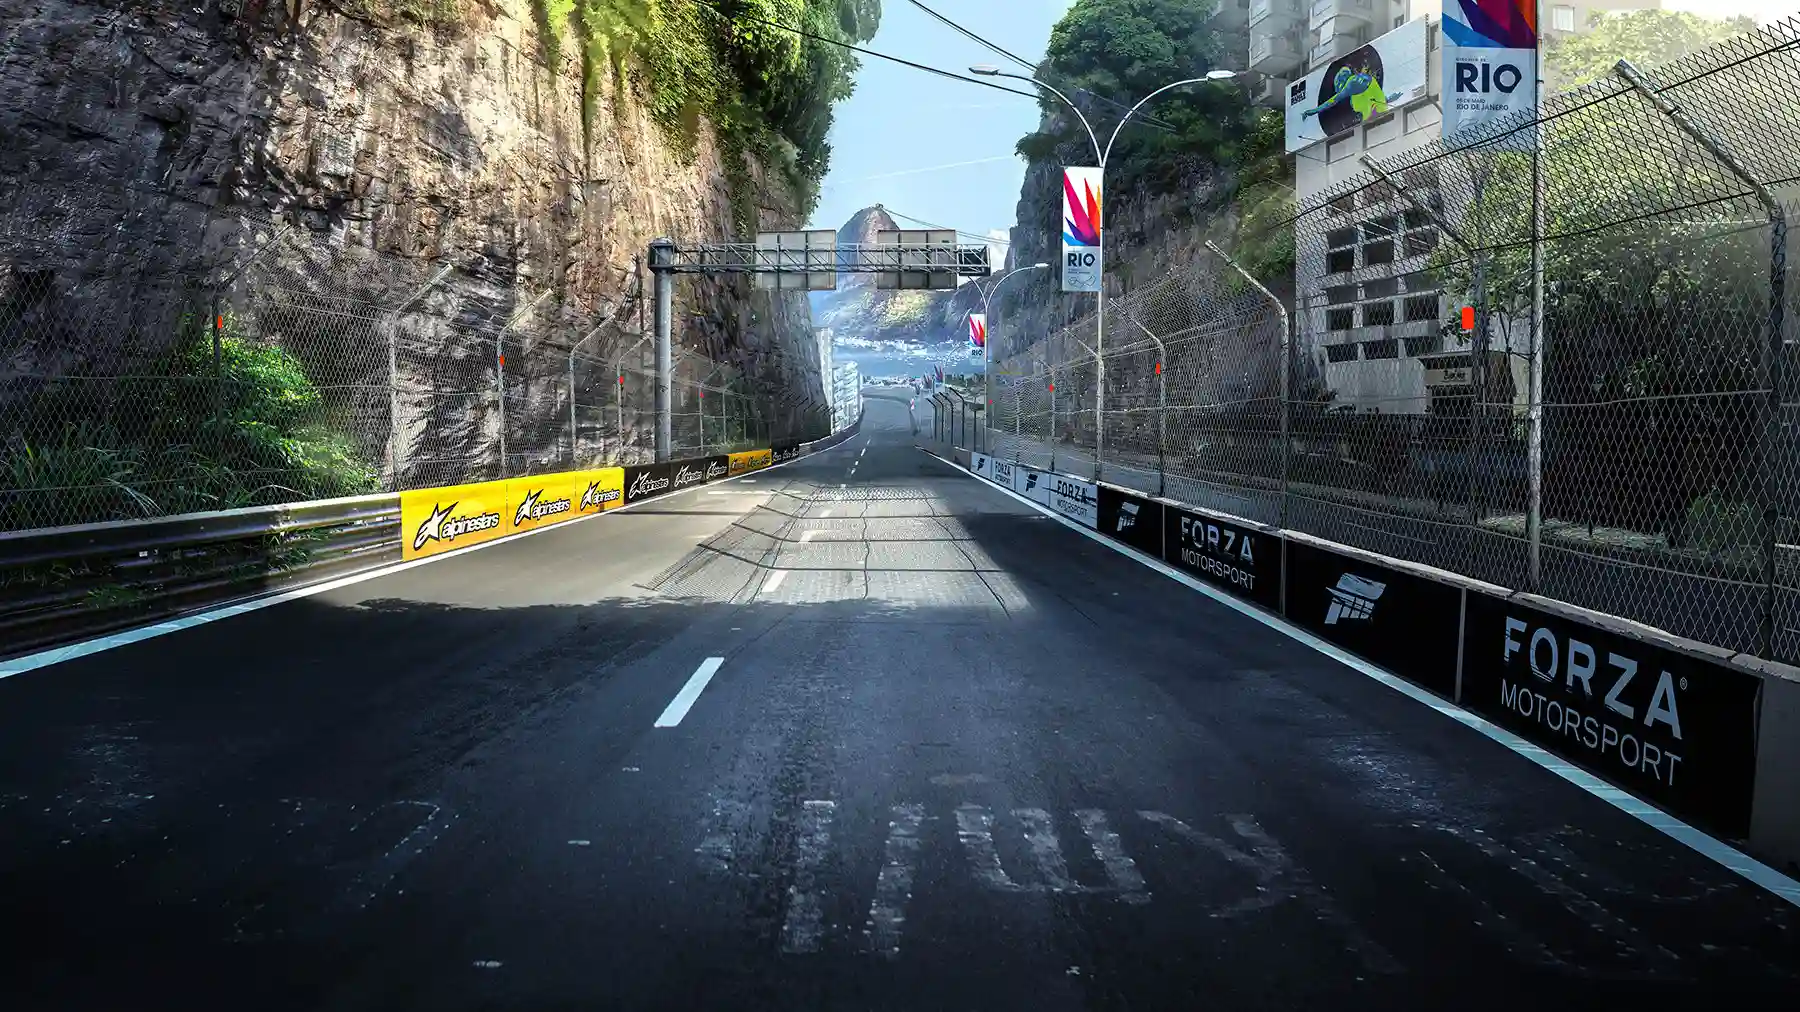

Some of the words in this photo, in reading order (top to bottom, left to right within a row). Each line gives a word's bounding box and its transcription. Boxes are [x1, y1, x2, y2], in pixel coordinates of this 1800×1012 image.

[1456, 63, 1522, 93] RIO
[1067, 252, 1096, 267] RIO
[995, 460, 1011, 476] FORZA
[1057, 480, 1088, 503] FORZA
[532, 499, 571, 520] alpinestars
[441, 511, 499, 541] alpinestars
[1181, 516, 1254, 565] FORZA
[1181, 547, 1256, 590] MOTORSPORT
[1501, 678, 1682, 786] MOTORSPORT
